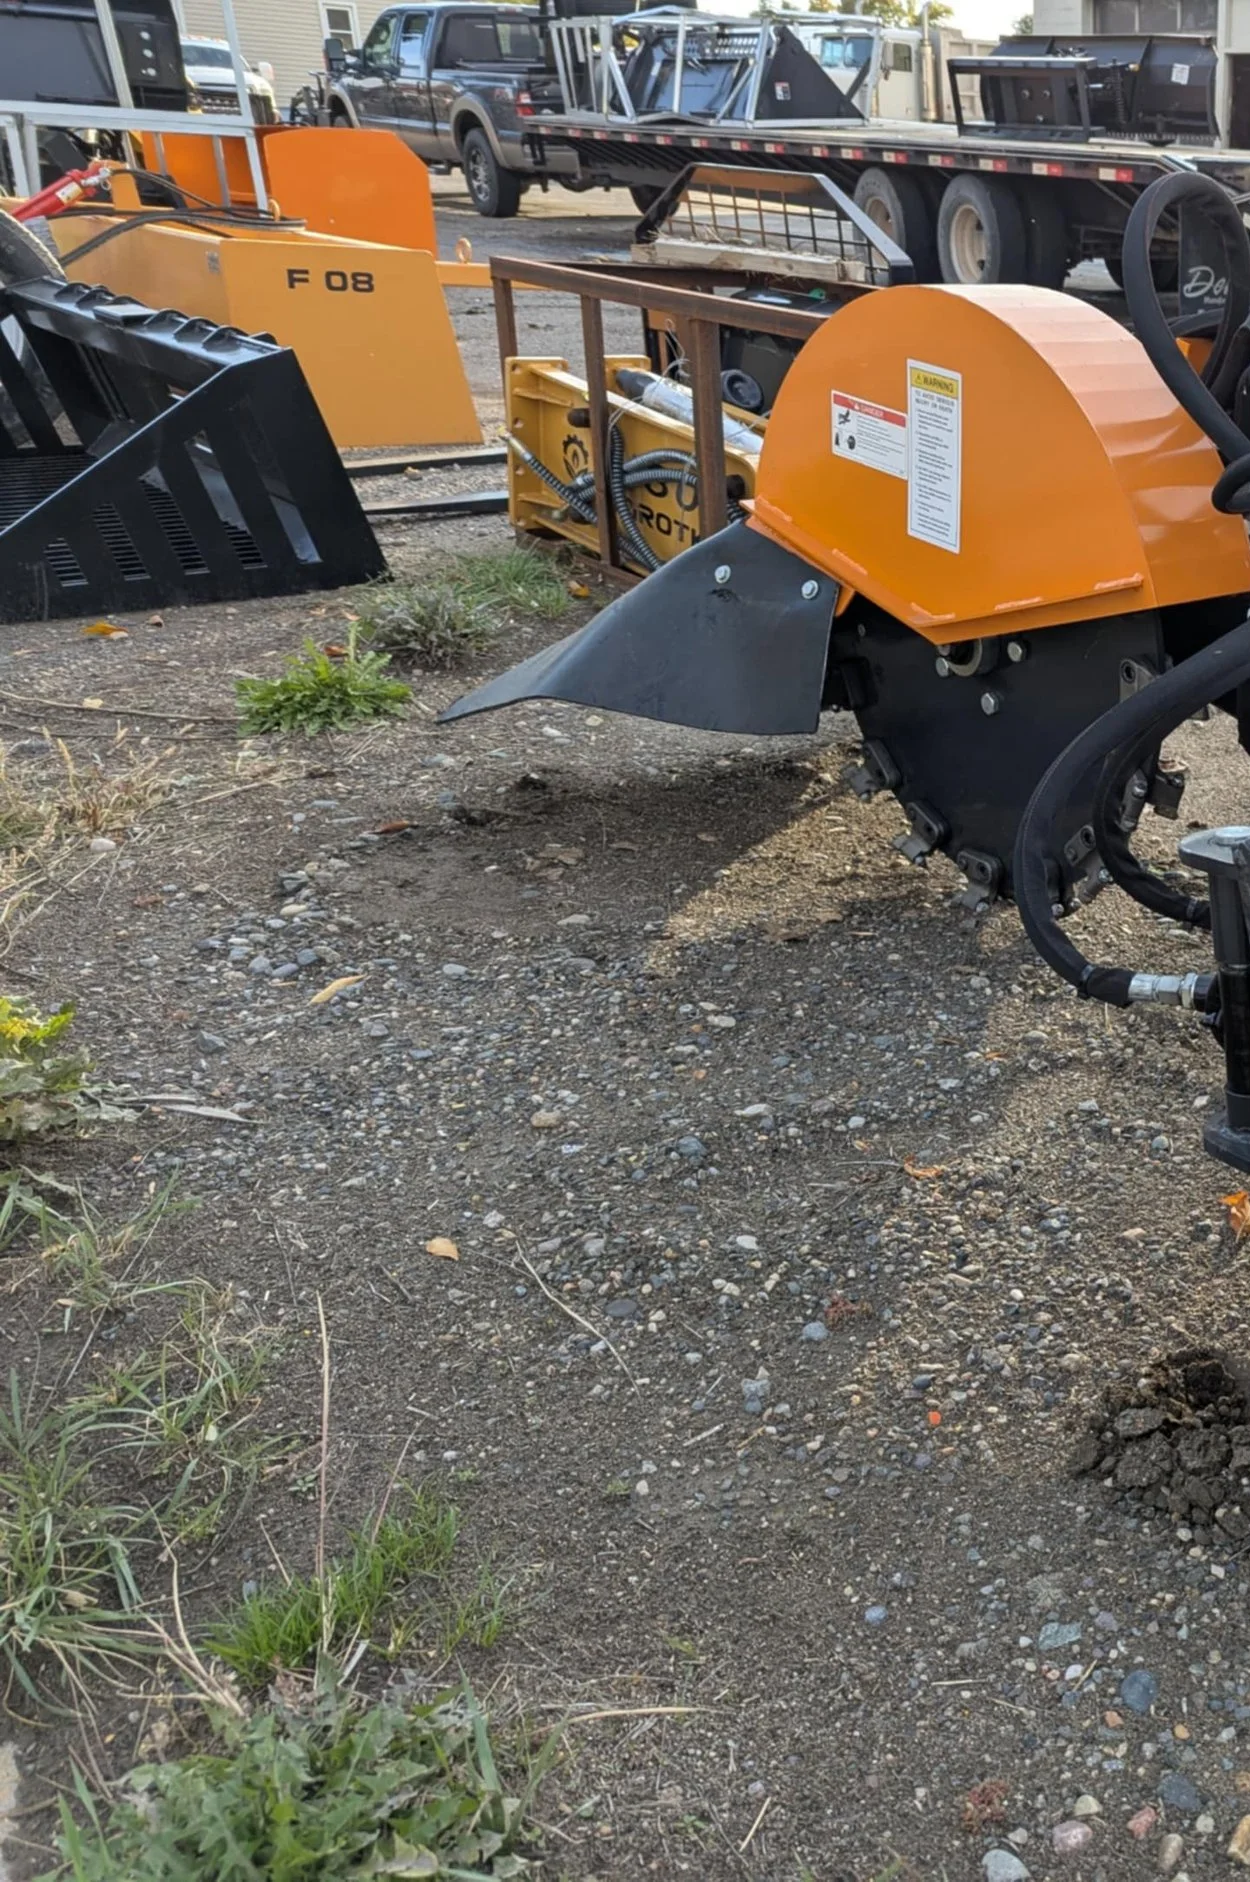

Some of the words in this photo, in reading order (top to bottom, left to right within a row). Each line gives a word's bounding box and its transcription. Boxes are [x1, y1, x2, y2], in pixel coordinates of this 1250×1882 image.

[287, 269, 309, 289] F
[324, 271, 375, 293] 08
[923, 375, 955, 394] WARNING
